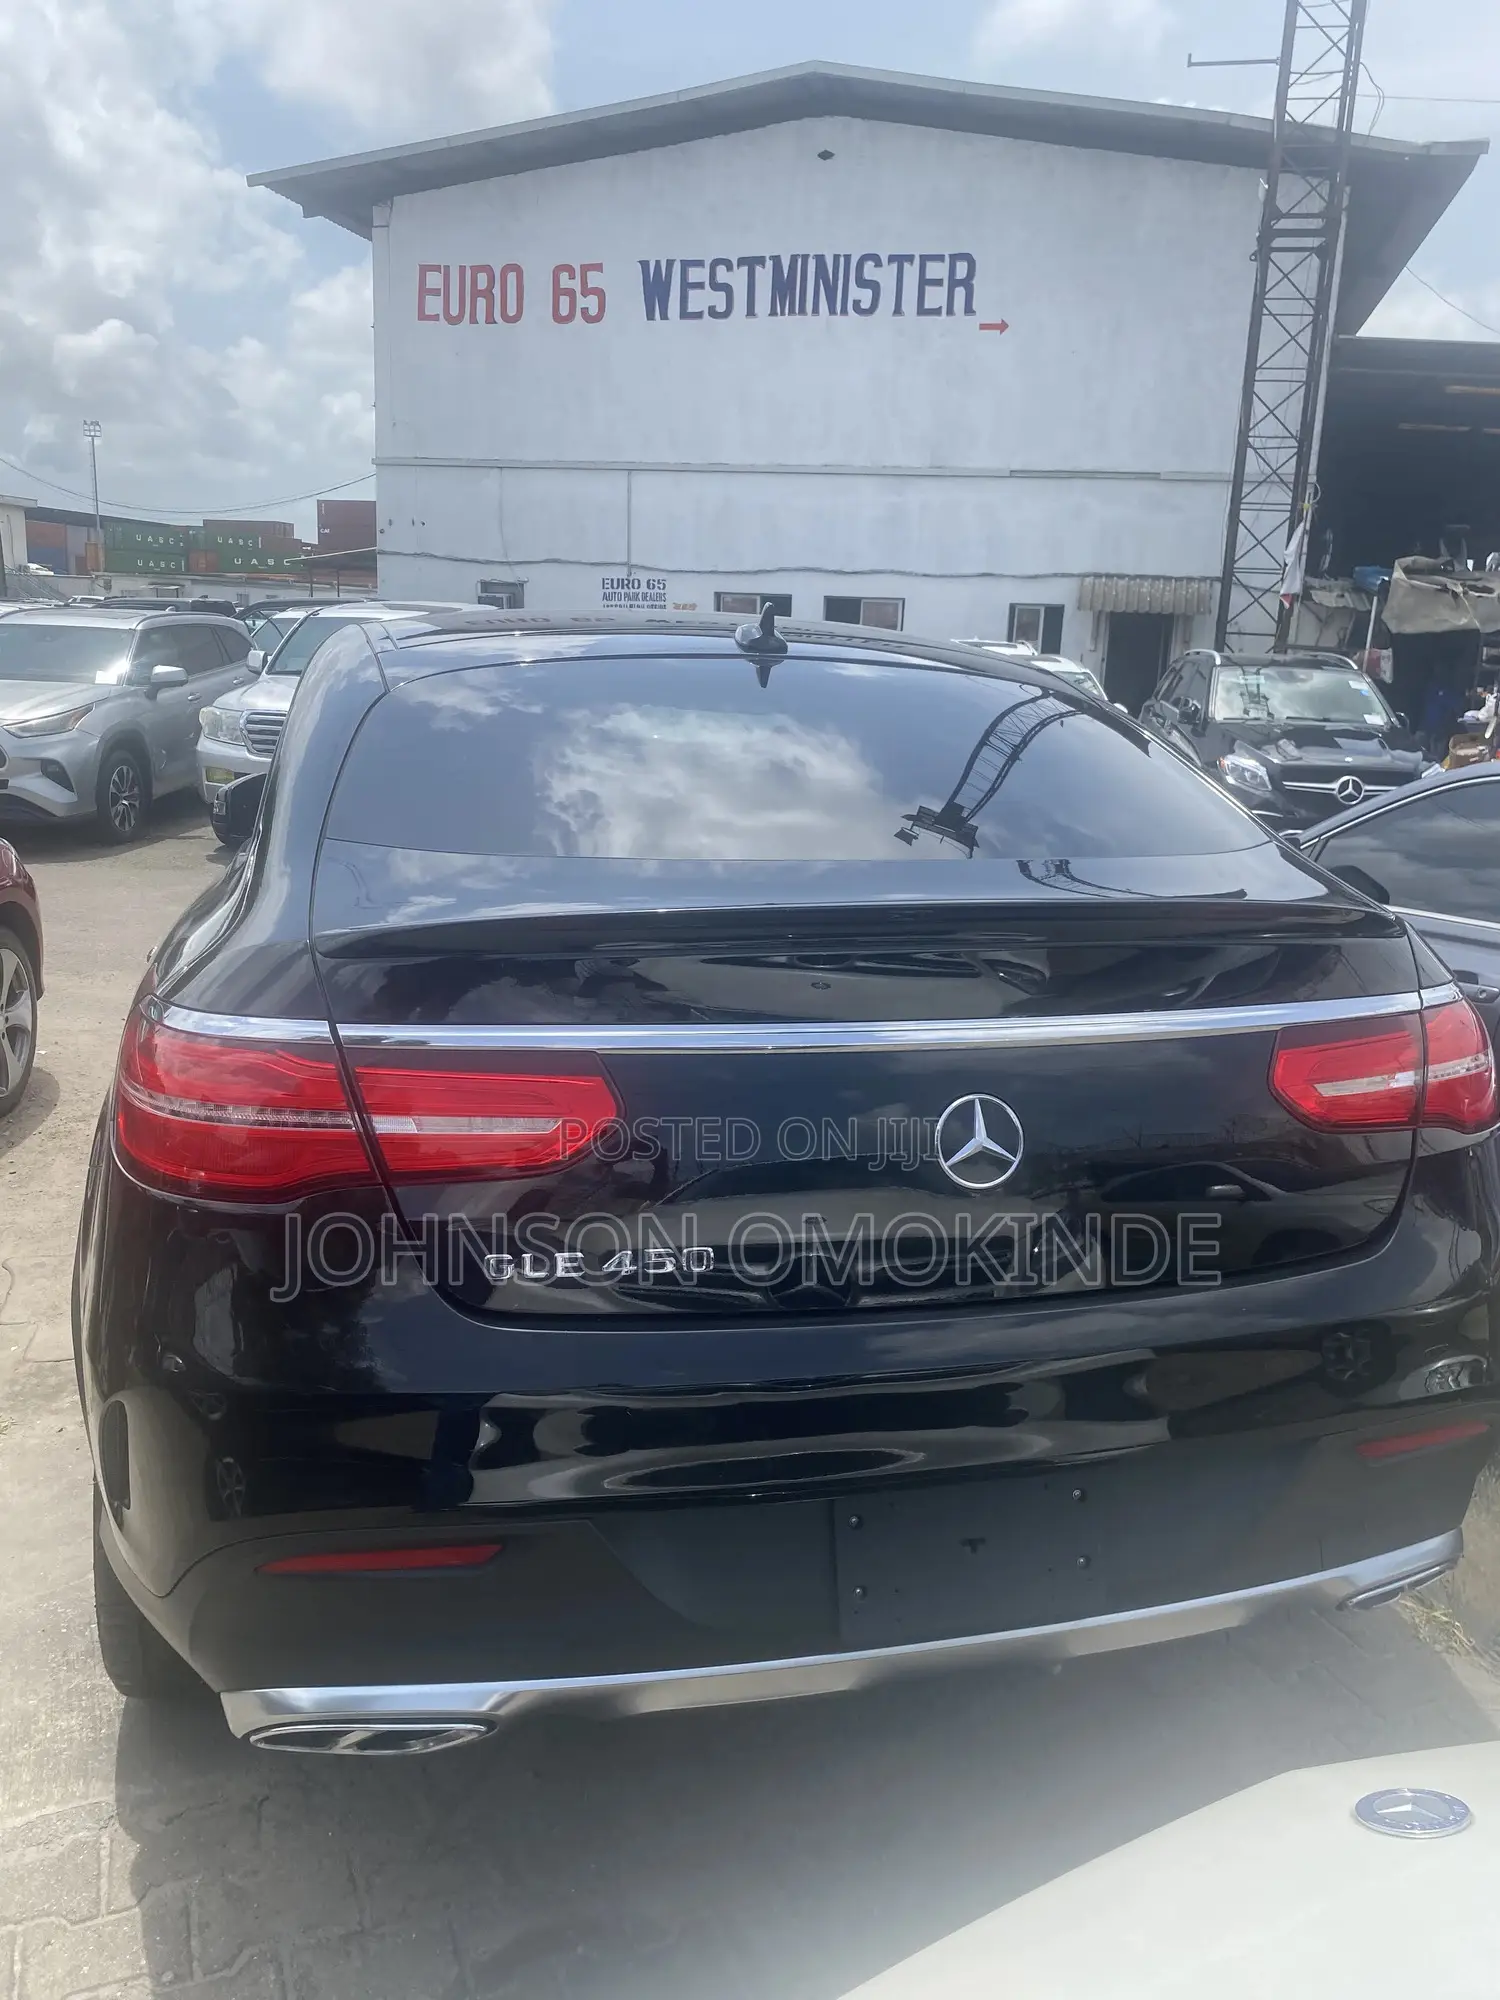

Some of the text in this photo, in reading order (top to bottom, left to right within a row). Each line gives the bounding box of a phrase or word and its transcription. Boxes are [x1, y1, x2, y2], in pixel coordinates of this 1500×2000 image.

[417, 252, 977, 326] EURO 65 WESTMINISTER
[135, 534, 175, 545] UASC
[217, 536, 253, 547] UASC
[137, 559, 176, 569] UASC
[234, 557, 292, 566] UASC
[601, 577, 667, 591] EURO 65
[601, 591, 667, 603] AUTO PARK DEALERS
[483, 1245, 717, 1280] GLE 450
